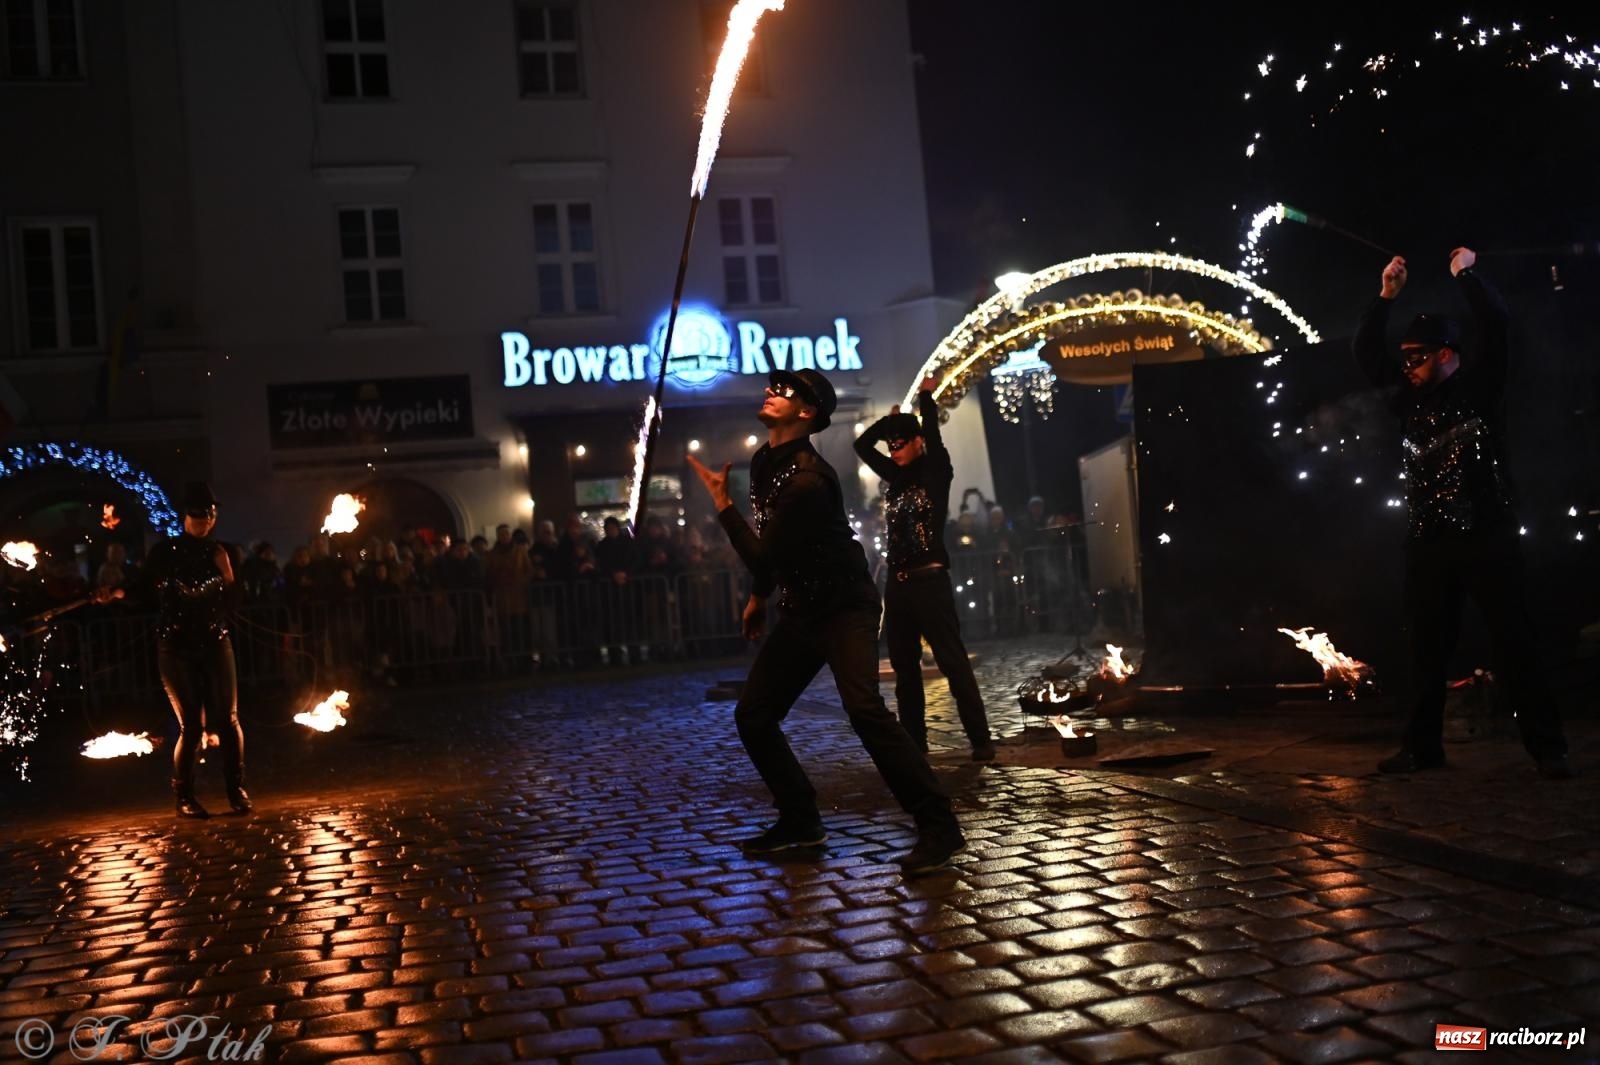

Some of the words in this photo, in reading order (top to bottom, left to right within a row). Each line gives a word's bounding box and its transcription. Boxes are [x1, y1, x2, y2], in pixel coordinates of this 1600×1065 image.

[501, 331, 649, 387] Browar
[737, 318, 862, 374] Rynek
[1134, 336, 1175, 351] Świąt
[354, 399, 460, 432] Wypieki
